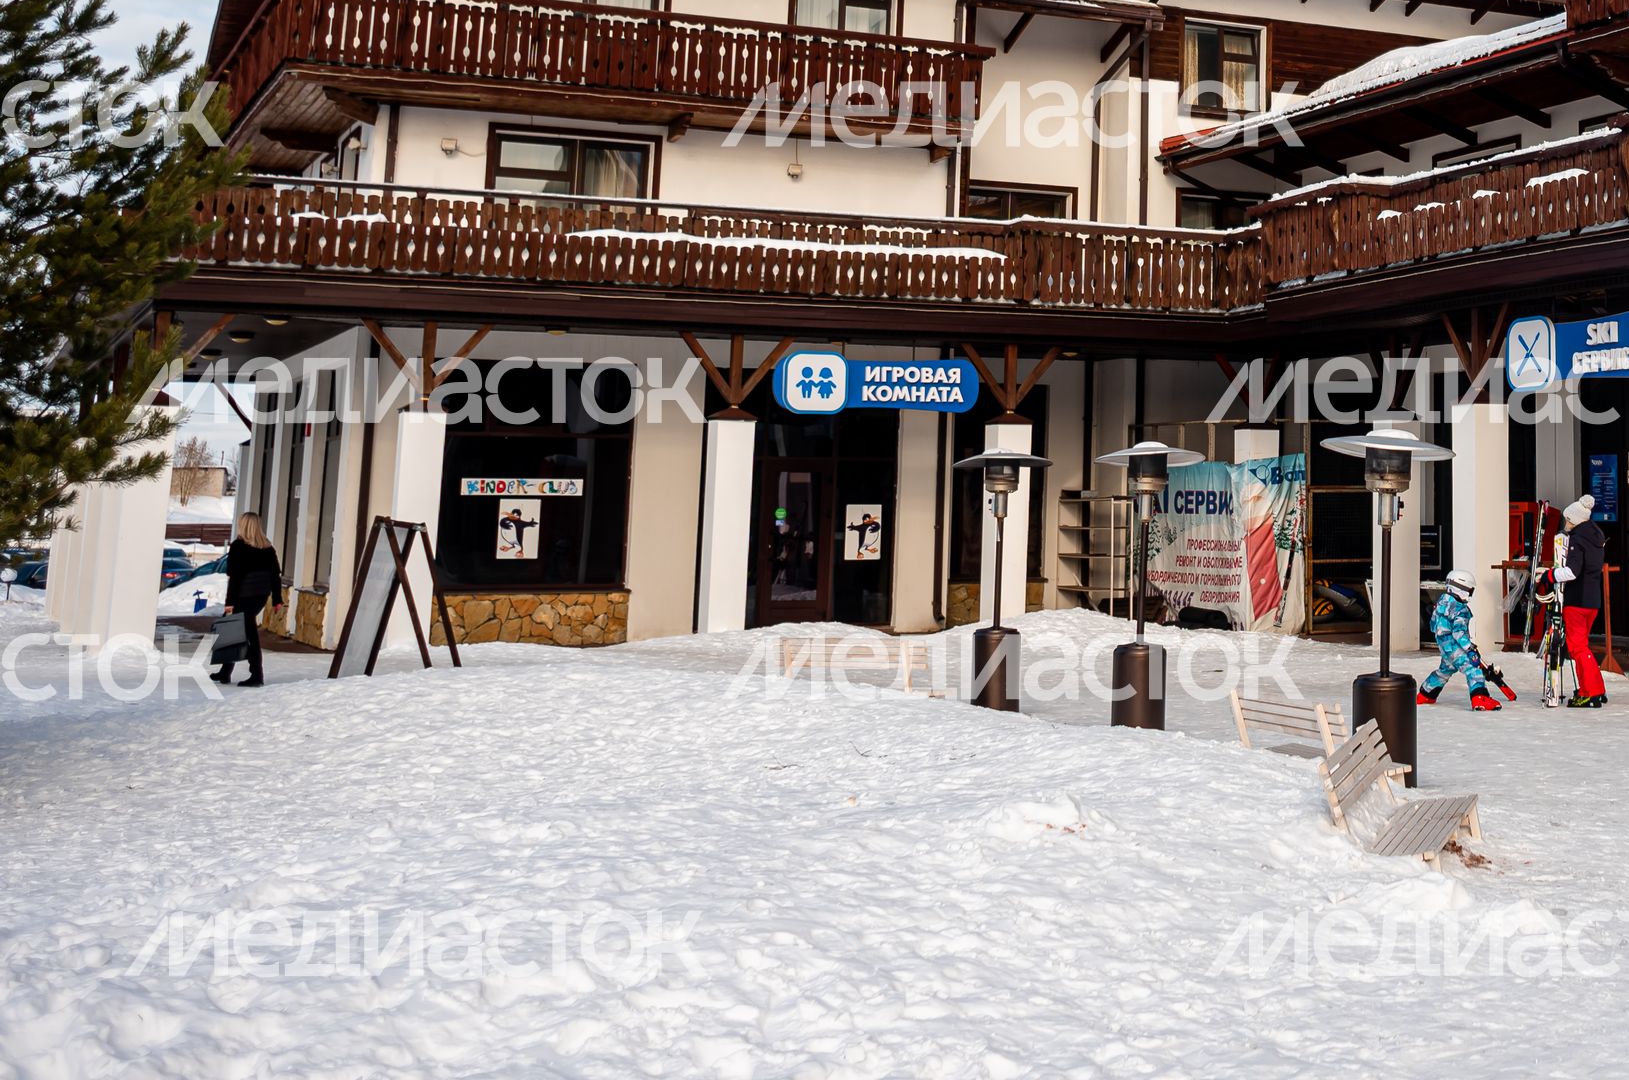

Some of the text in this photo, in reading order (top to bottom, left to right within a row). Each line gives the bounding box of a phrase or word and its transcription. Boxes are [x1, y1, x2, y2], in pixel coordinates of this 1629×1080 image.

[1586, 321, 1618, 346] SKI
[865, 366, 961, 384] ИГРОВАЯ
[862, 385, 964, 403] КОМНАТА
